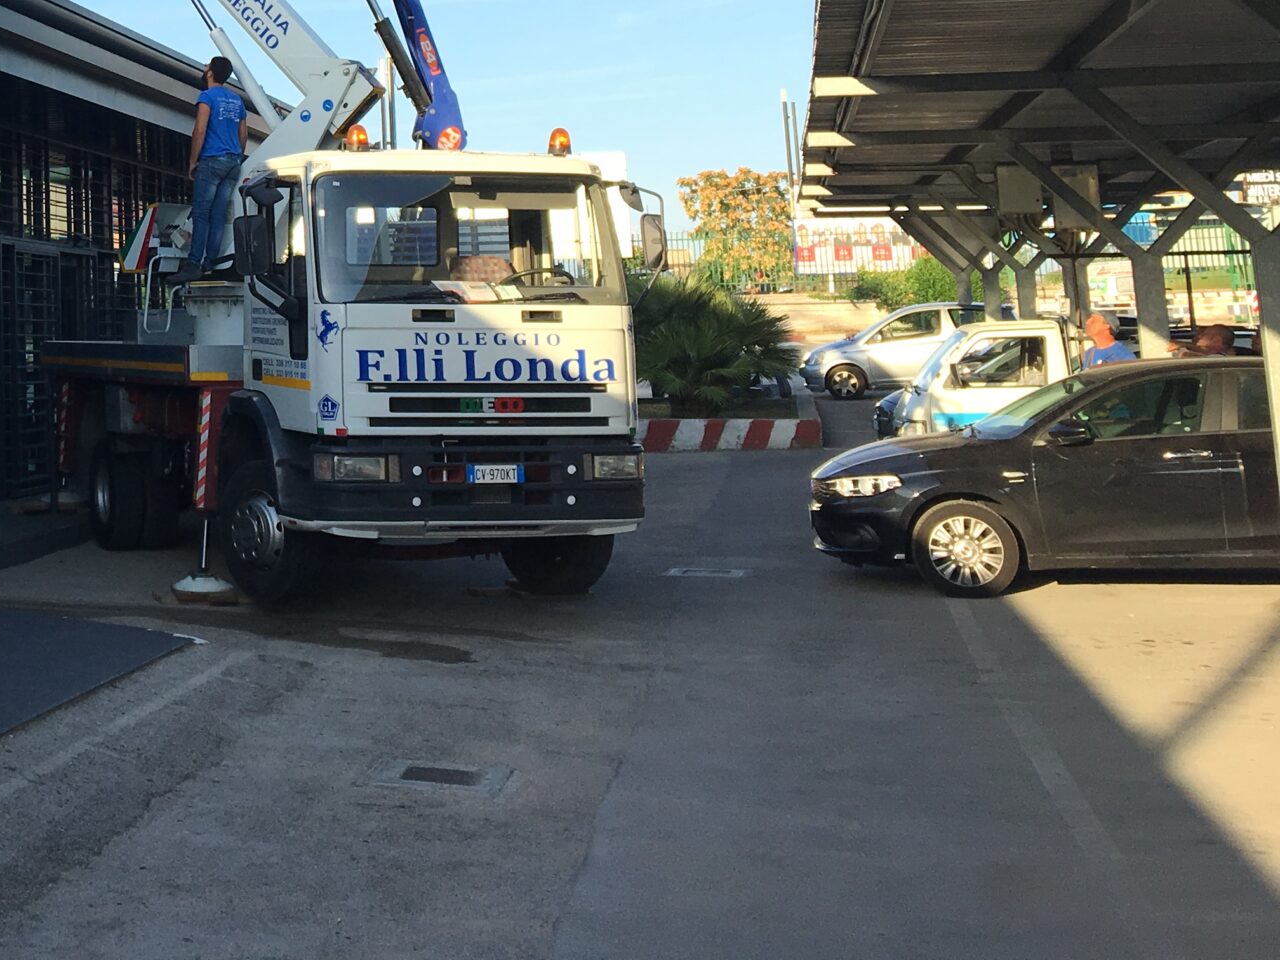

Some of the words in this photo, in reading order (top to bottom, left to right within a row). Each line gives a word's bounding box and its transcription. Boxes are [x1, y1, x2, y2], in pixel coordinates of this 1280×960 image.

[414, 332, 561, 346] NOLEGGIO
[355, 348, 447, 382] F.lli
[463, 349, 617, 382] Londa
[320, 401, 336, 412] GL
